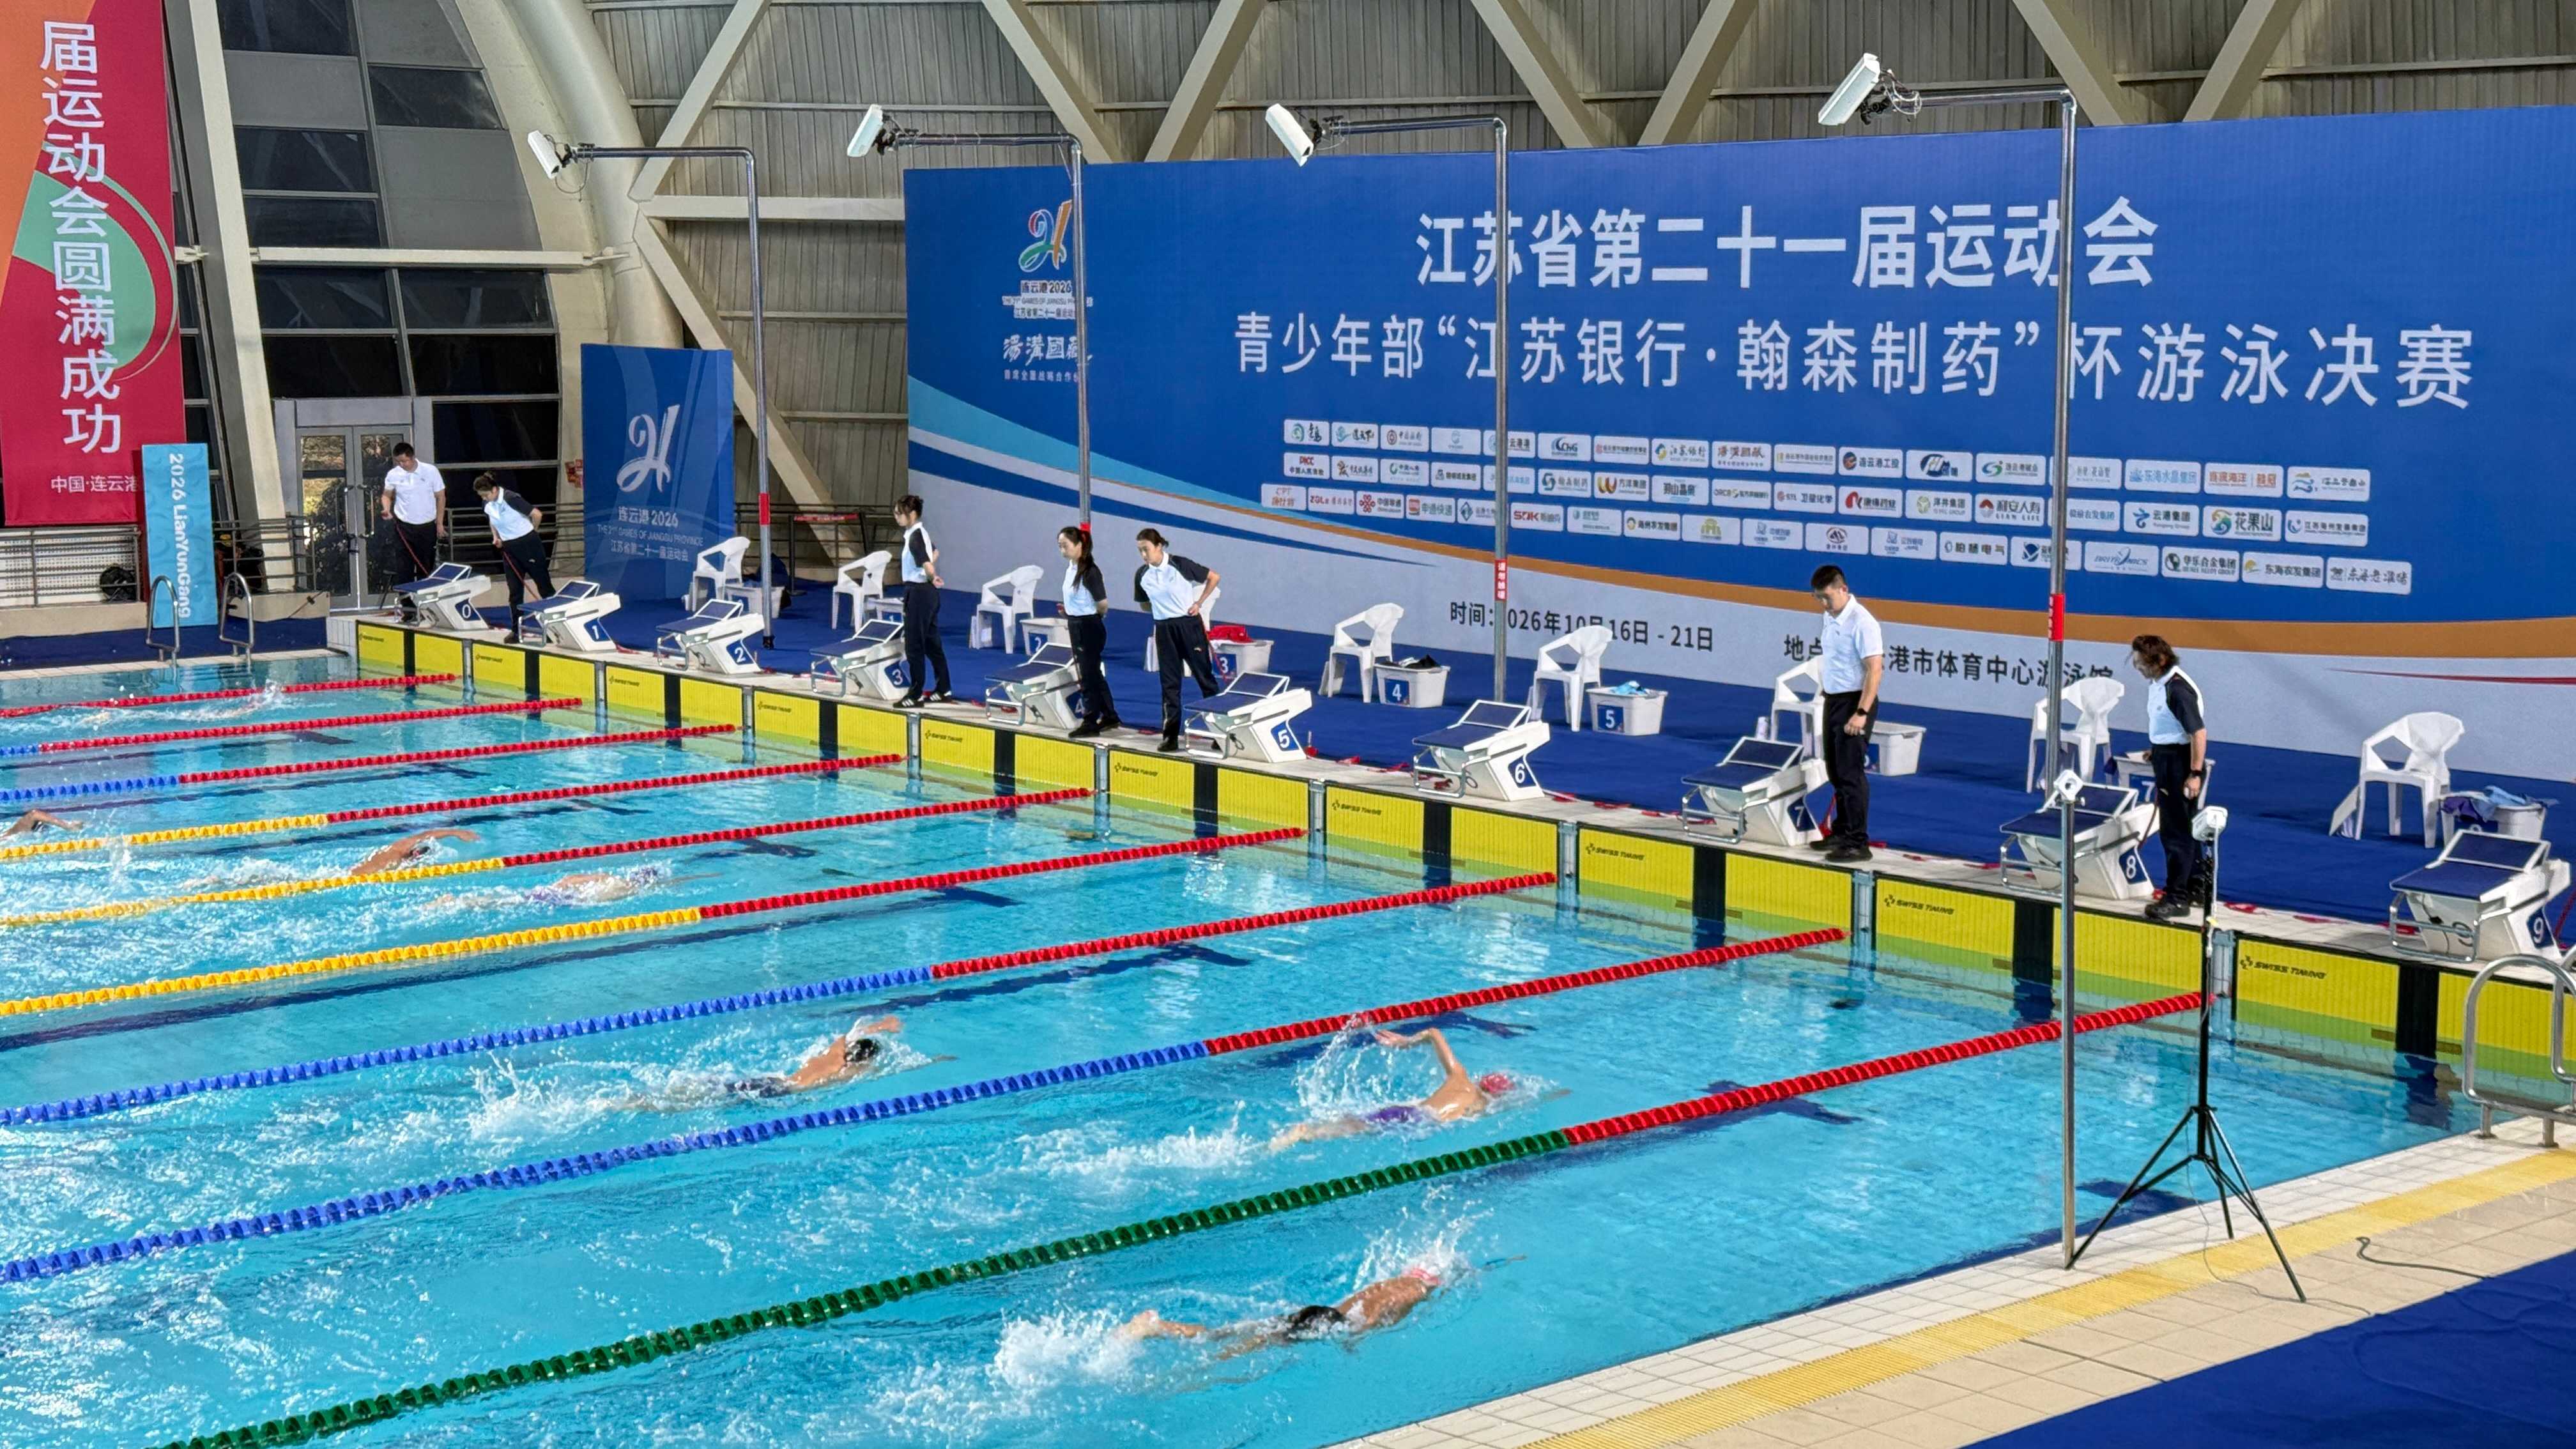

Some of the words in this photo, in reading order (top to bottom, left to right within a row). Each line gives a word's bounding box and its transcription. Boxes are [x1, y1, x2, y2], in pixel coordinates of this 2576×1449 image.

[40, 20, 122, 454] 届运动会圆满成功
[1416, 196, 2156, 289] 江苏省第二十一届运动会
[169, 453, 186, 501] 2026
[2234, 511, 2274, 532] 花果山
[461, 604, 471, 618] 0
[592, 625, 599, 640] 1
[734, 647, 745, 663] 2
[1220, 657, 1229, 673] 3
[892, 669, 903, 686] 3
[1392, 684, 1402, 702] 4
[1606, 710, 1616, 729] 5
[1277, 729, 1290, 748] 5
[1514, 763, 1526, 783] 6
[2141, 781, 2156, 802] 7
[1794, 806, 1805, 827] 7
[2126, 855, 2137, 879] 8
[1896, 900, 1924, 910] SWISS
[1926, 905, 1954, 915] TIMING
[2533, 917, 2544, 944] 9
[2254, 961, 2288, 973] SWISS
[2290, 967, 2327, 979] TIMING
